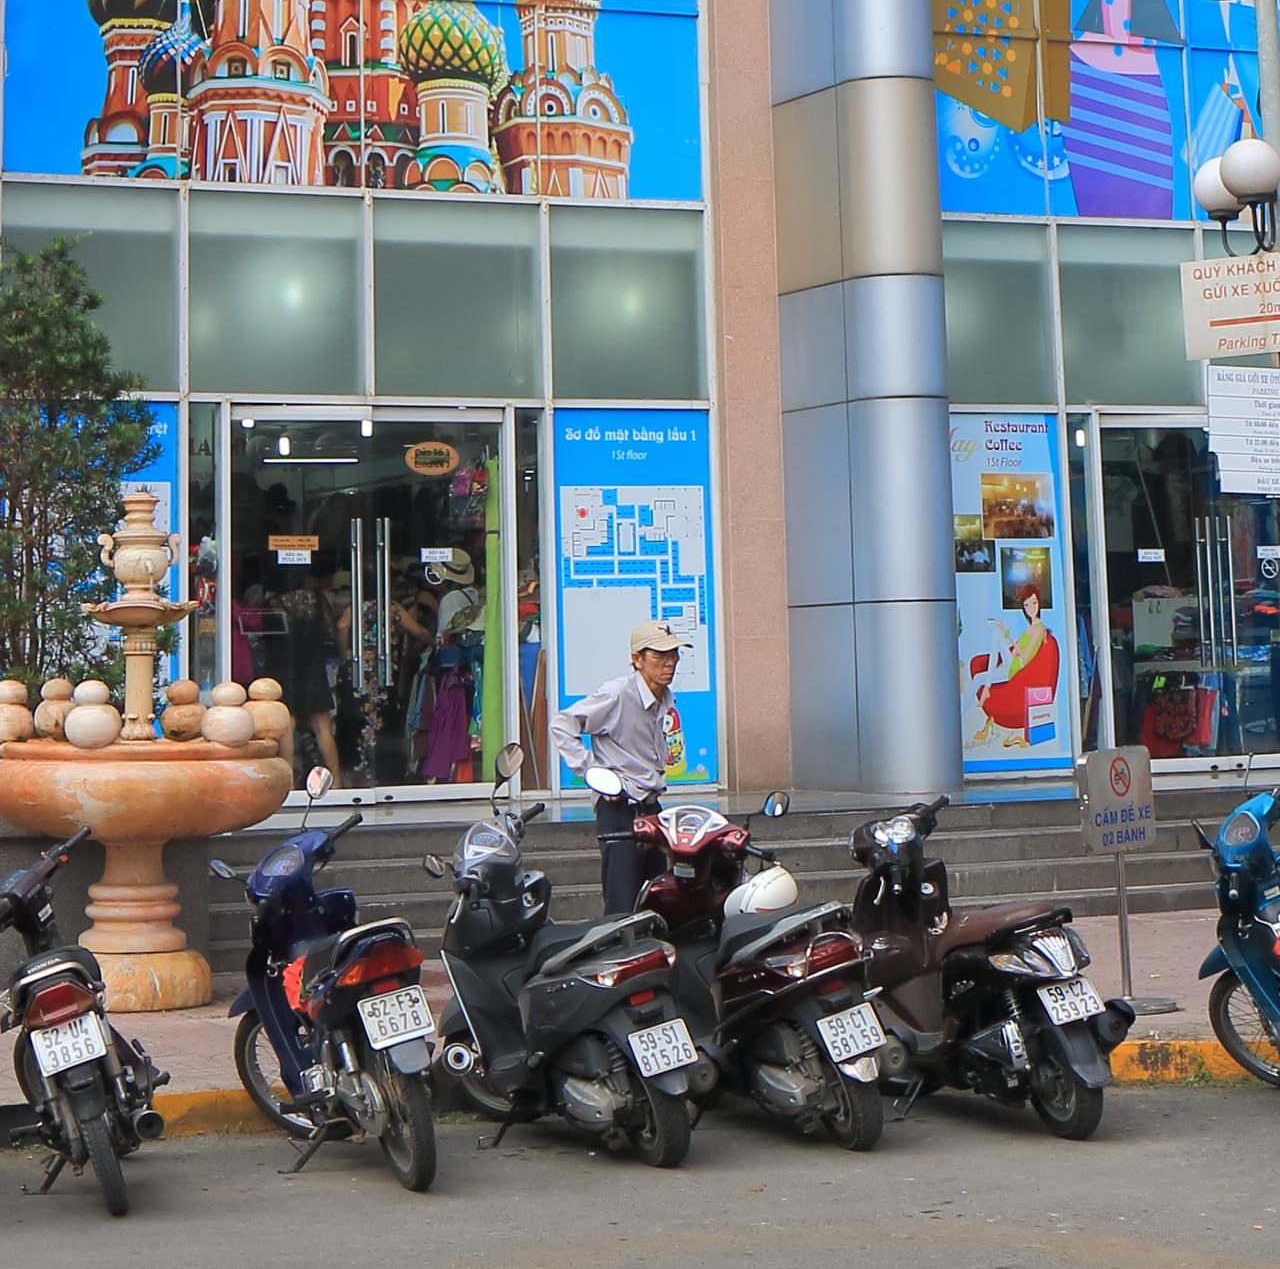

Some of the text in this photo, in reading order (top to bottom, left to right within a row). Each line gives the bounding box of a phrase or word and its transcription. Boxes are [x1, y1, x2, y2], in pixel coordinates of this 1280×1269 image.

[1192, 264, 1221, 281] QUÝ
[1226, 259, 1276, 277] KHÁCH
[1231, 284, 1249, 296] XE
[1218, 336, 1267, 351] Parking
[1252, 388, 1279, 397] PARKING
[565, 428, 581, 441] Sơ
[690, 429, 696, 441] 1
[984, 420, 1049, 434] Restaurant
[611, 449, 648, 461] 1St floor
[985, 438, 1023, 451] Coffee
[987, 457, 1022, 468] 1St Floor
[1138, 805, 1151, 820] XE
[1102, 826, 1146, 847] 02 BÁNH
[27, 957, 62, 974] HONDA
[1046, 980, 1088, 1003] 59-C2
[369, 992, 416, 1019] 62-F3
[1051, 995, 1100, 1022] 259.23
[377, 1010, 422, 1036] 6678
[827, 1009, 868, 1037] 59-C1
[42, 1019, 89, 1050] 52-U4
[638, 1025, 681, 1052] 59-S1
[830, 1026, 882, 1058] 581.59
[48, 1037, 96, 1069] 3856
[641, 1042, 694, 1073] 815.26
